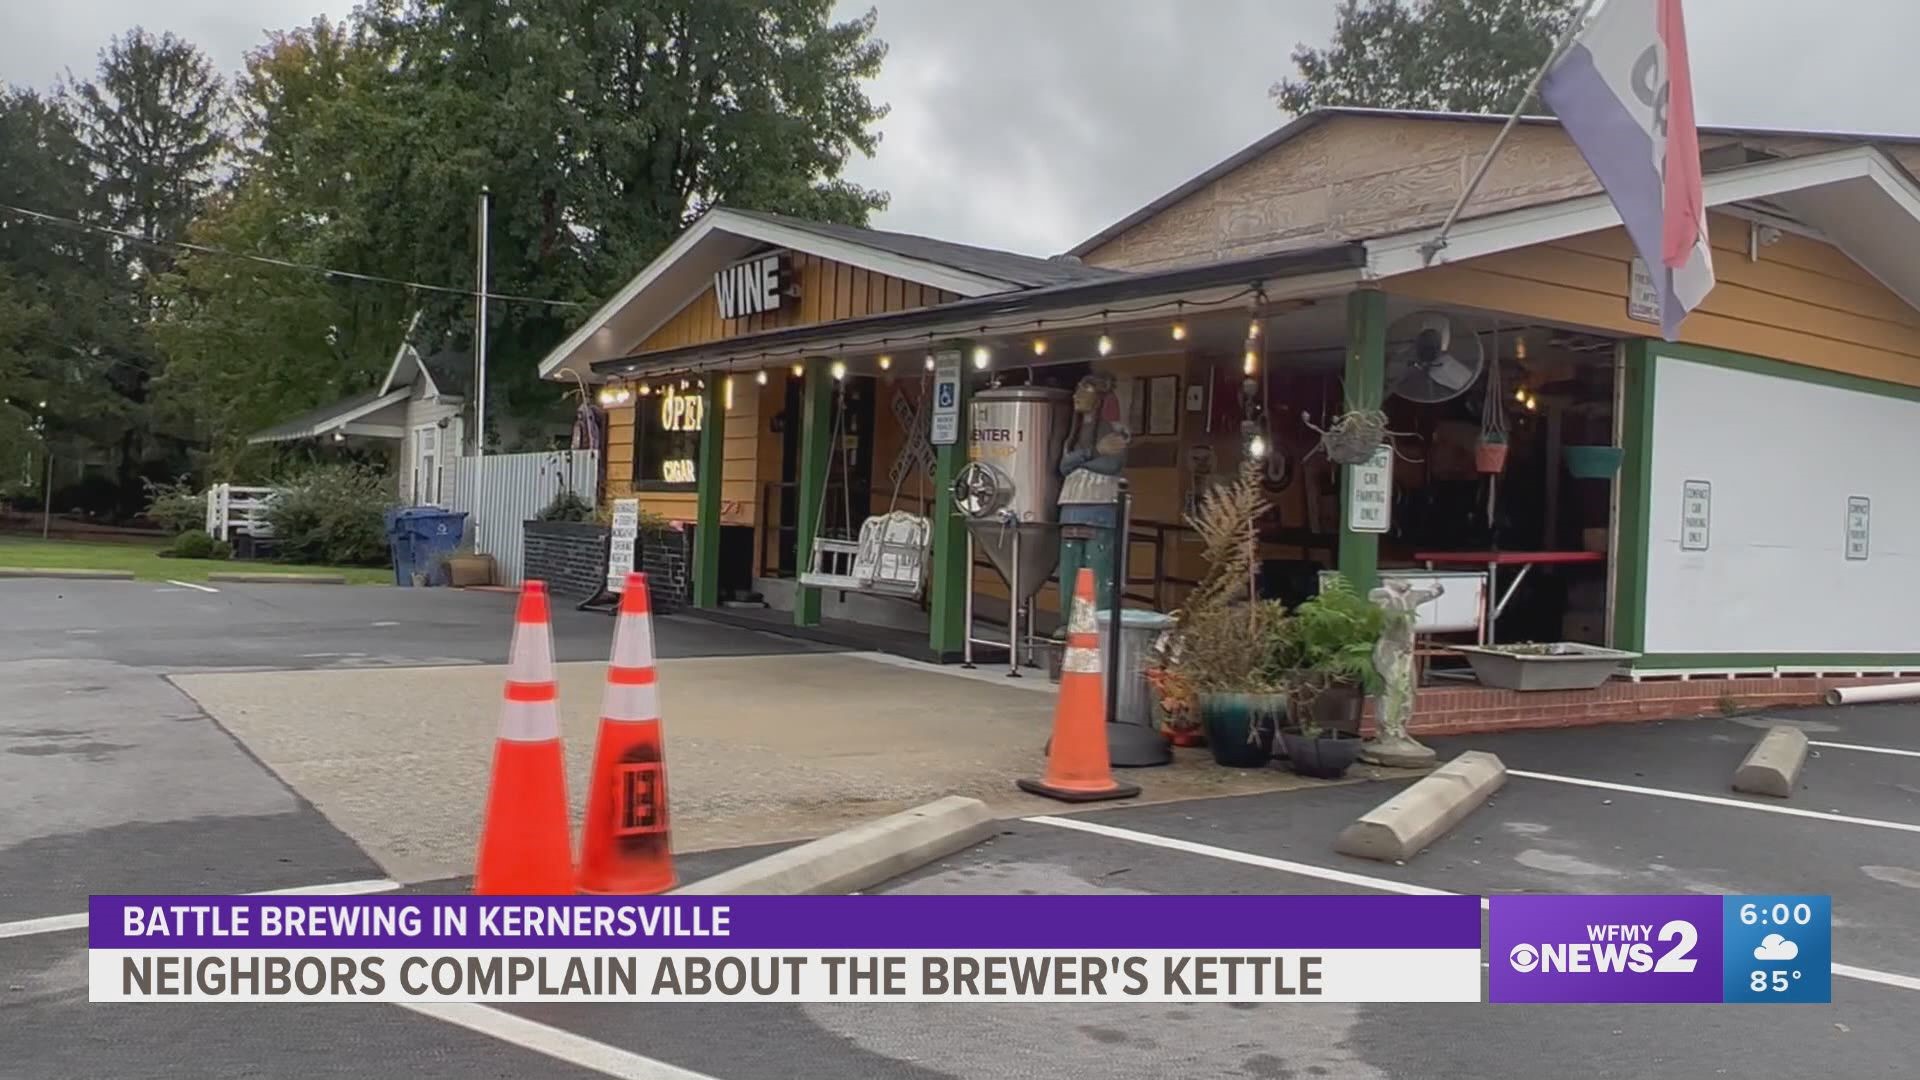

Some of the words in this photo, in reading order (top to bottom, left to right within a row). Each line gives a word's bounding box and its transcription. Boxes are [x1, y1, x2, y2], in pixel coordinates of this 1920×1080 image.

[714, 256, 780, 320] WINE
[1018, 430, 1024, 441] 1
[663, 459, 696, 482] CIGAR
